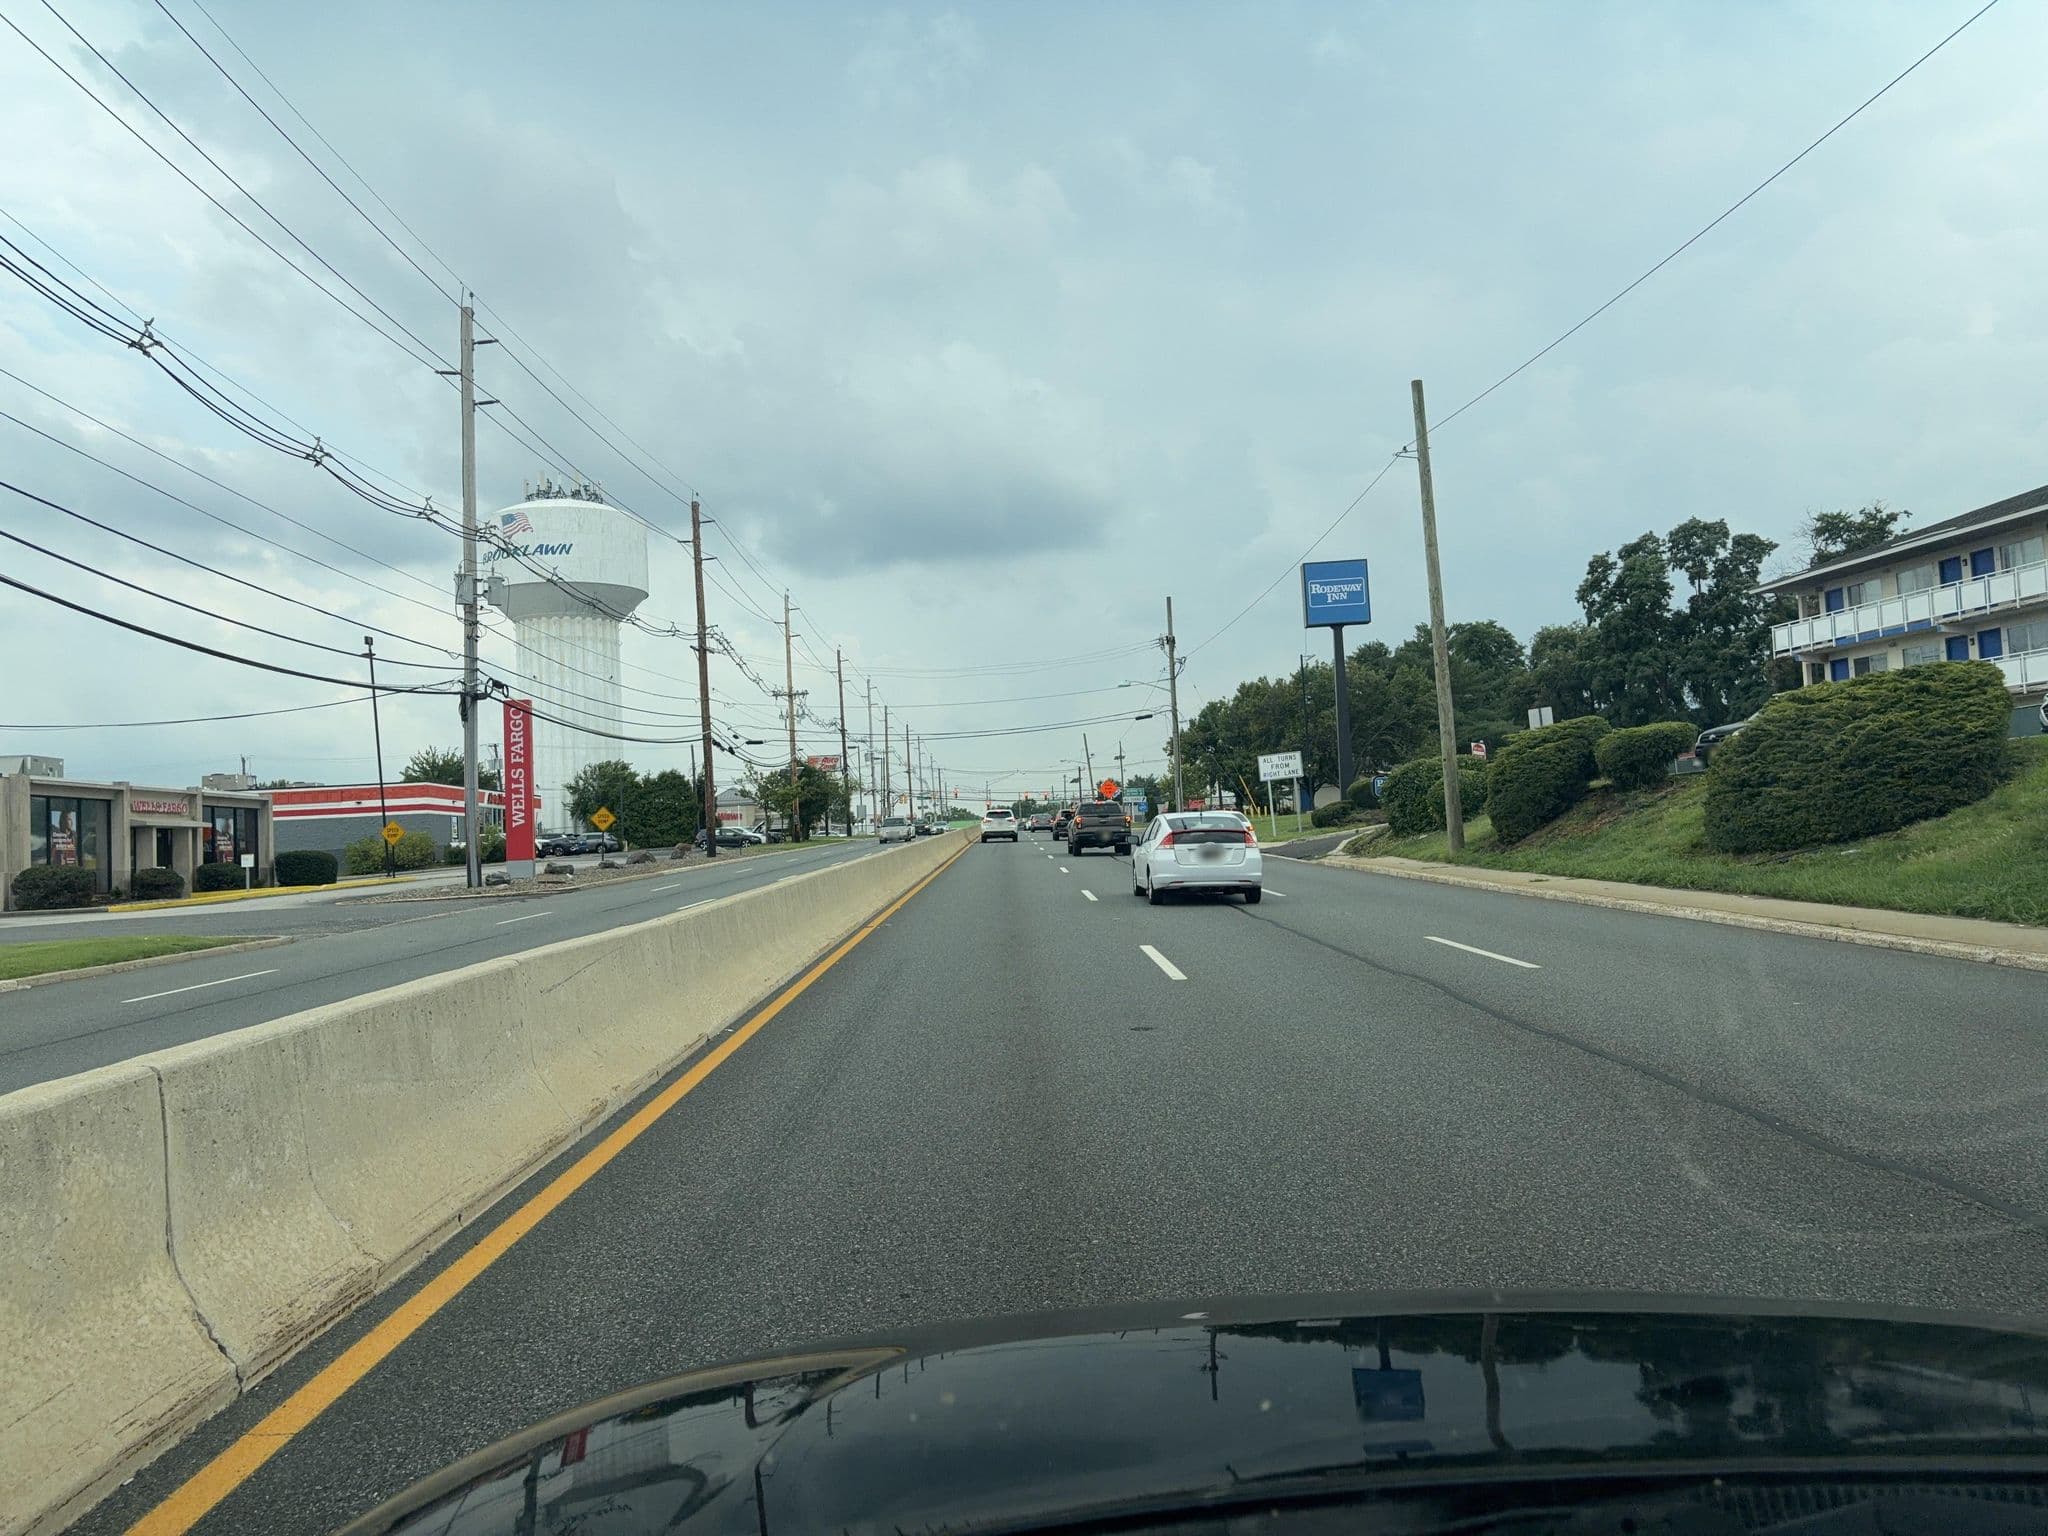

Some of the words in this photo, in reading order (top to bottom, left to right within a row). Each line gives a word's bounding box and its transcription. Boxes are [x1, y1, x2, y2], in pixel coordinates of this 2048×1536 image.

[1311, 583, 1362, 594] RODEWAY
[1327, 592, 1347, 603] INN
[510, 706, 524, 764] FARGO
[1278, 754, 1297, 762] TURNS
[1271, 762, 1290, 770] FROM
[1284, 768, 1300, 776] LANE
[511, 768, 525, 828] WELLS
